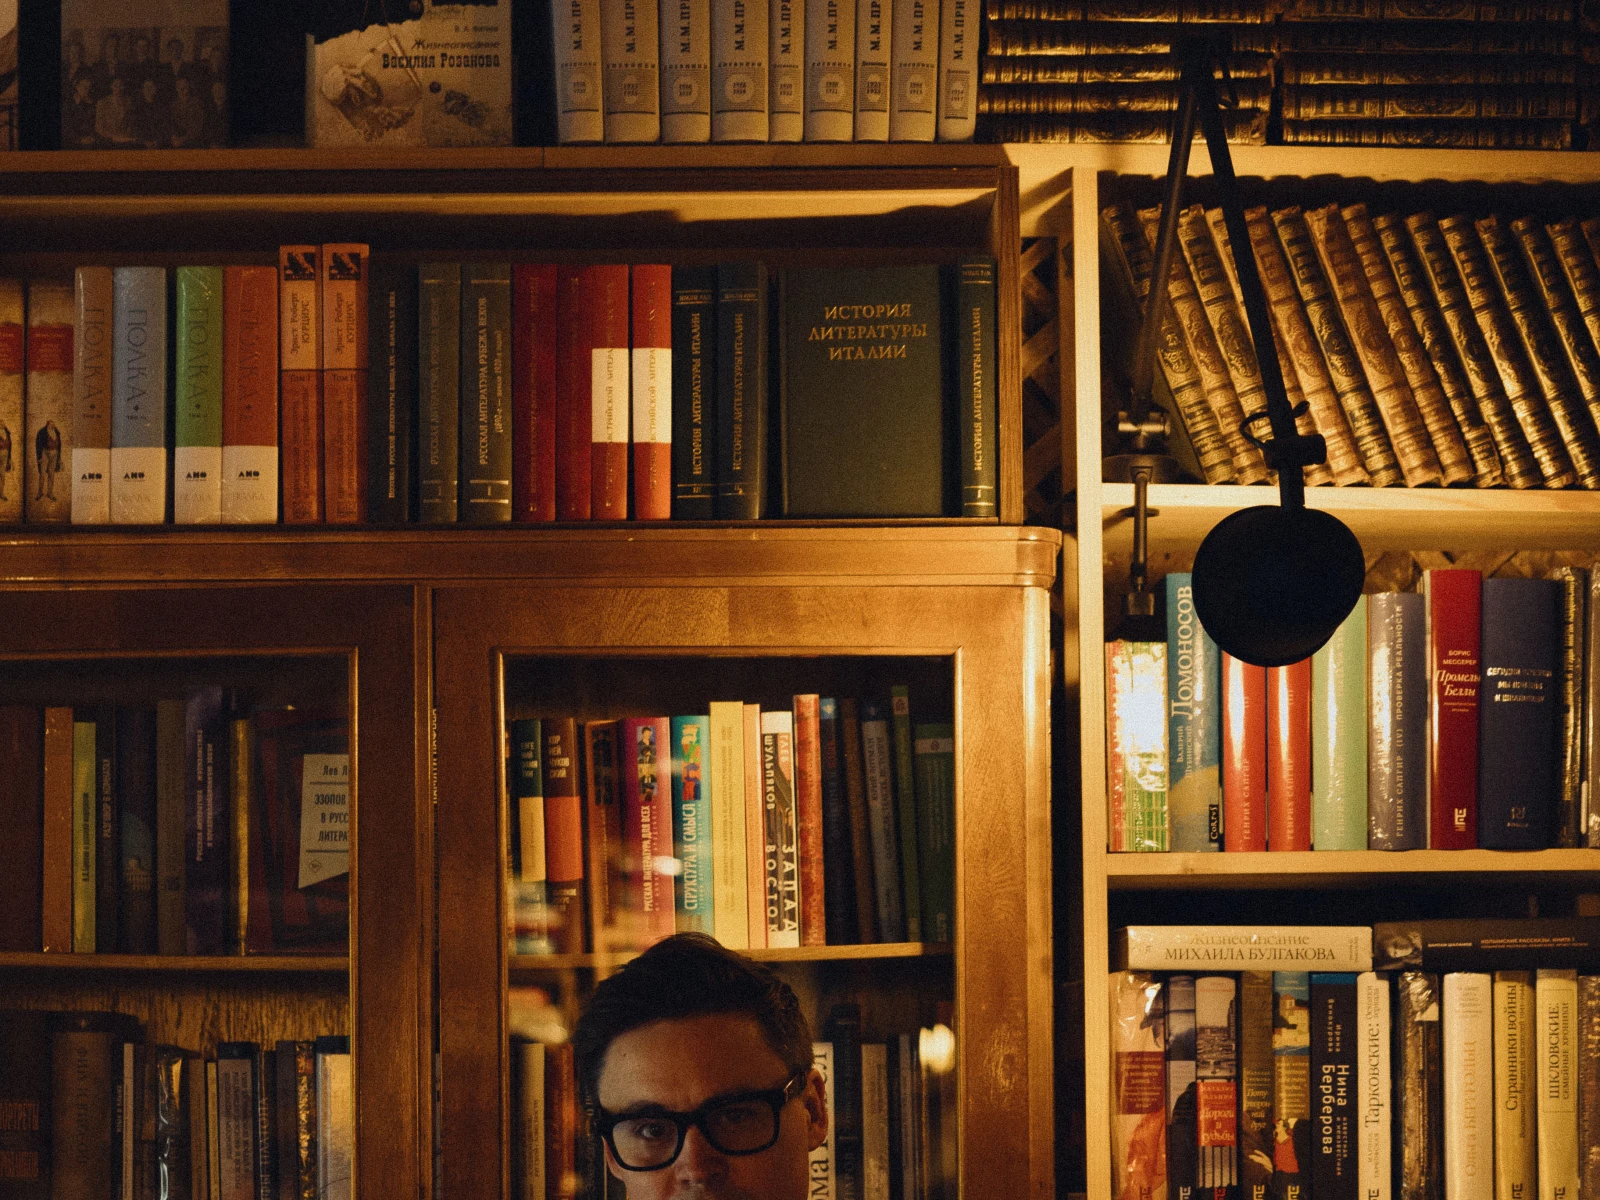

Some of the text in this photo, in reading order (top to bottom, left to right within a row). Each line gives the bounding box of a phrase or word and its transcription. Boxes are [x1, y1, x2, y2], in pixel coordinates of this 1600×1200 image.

[382, 53, 500, 69] Василия Розанова
[84, 308, 104, 399] ПОЛКА
[127, 308, 147, 401] ПОЛКА
[188, 308, 208, 400] ПОЛКА
[808, 323, 927, 341] ЛИТЕРАТУРЫ
[824, 304, 911, 320] ИСТОРИЯ
[829, 344, 907, 361] ИТАЛИИ
[478, 297, 488, 465] РУССКАЯ ЛИТЕРАТУРА РУБЕЖА ВЕКОВ
[691, 312, 702, 475] ИСТОРИЯ ЛИТЕРАТУРЫ ИТАЛИИ
[732, 313, 744, 471] ИСТОРИЯ ЛИТЕРАТУРЫ ИТАЛИИ
[973, 307, 983, 471] ИСТОРИЯ ЛИТЕРАТУРЫ ИТАЛИИ
[314, 794, 346, 805] ЭЗОПОВ
[322, 765, 338, 776] Лев
[764, 735, 776, 810] ШУЛЬПЯКОВ
[320, 812, 326, 823] В
[641, 805, 653, 912] РУССКАЯ ЛИТЕРАТУРА ДЛЯ ВСЕХ
[682, 803, 698, 910] СТРУКТУРА И СМЫСЛ
[766, 844, 779, 932] ВОСТОК
[783, 844, 798, 932] ЗАПАД
[1165, 947, 1245, 961] МИХАИЛА
[1249, 947, 1336, 961] БУЛГАКОВА
[1190, 934, 1310, 946] Жизнеописание
[1327, 998, 1335, 1053] Винокурова
[1504, 985, 1521, 1111] Странники войны
[1562, 1002, 1570, 1100] СЕМЕЙНЫЕ ХРОНИКИ
[1320, 1064, 1335, 1155] Берберова
[1336, 1064, 1350, 1106] Нина
[1364, 1023, 1383, 1128] Тарковские:
[1462, 1040, 1477, 1177] Ольга БЕРГГОЛЬЦ
